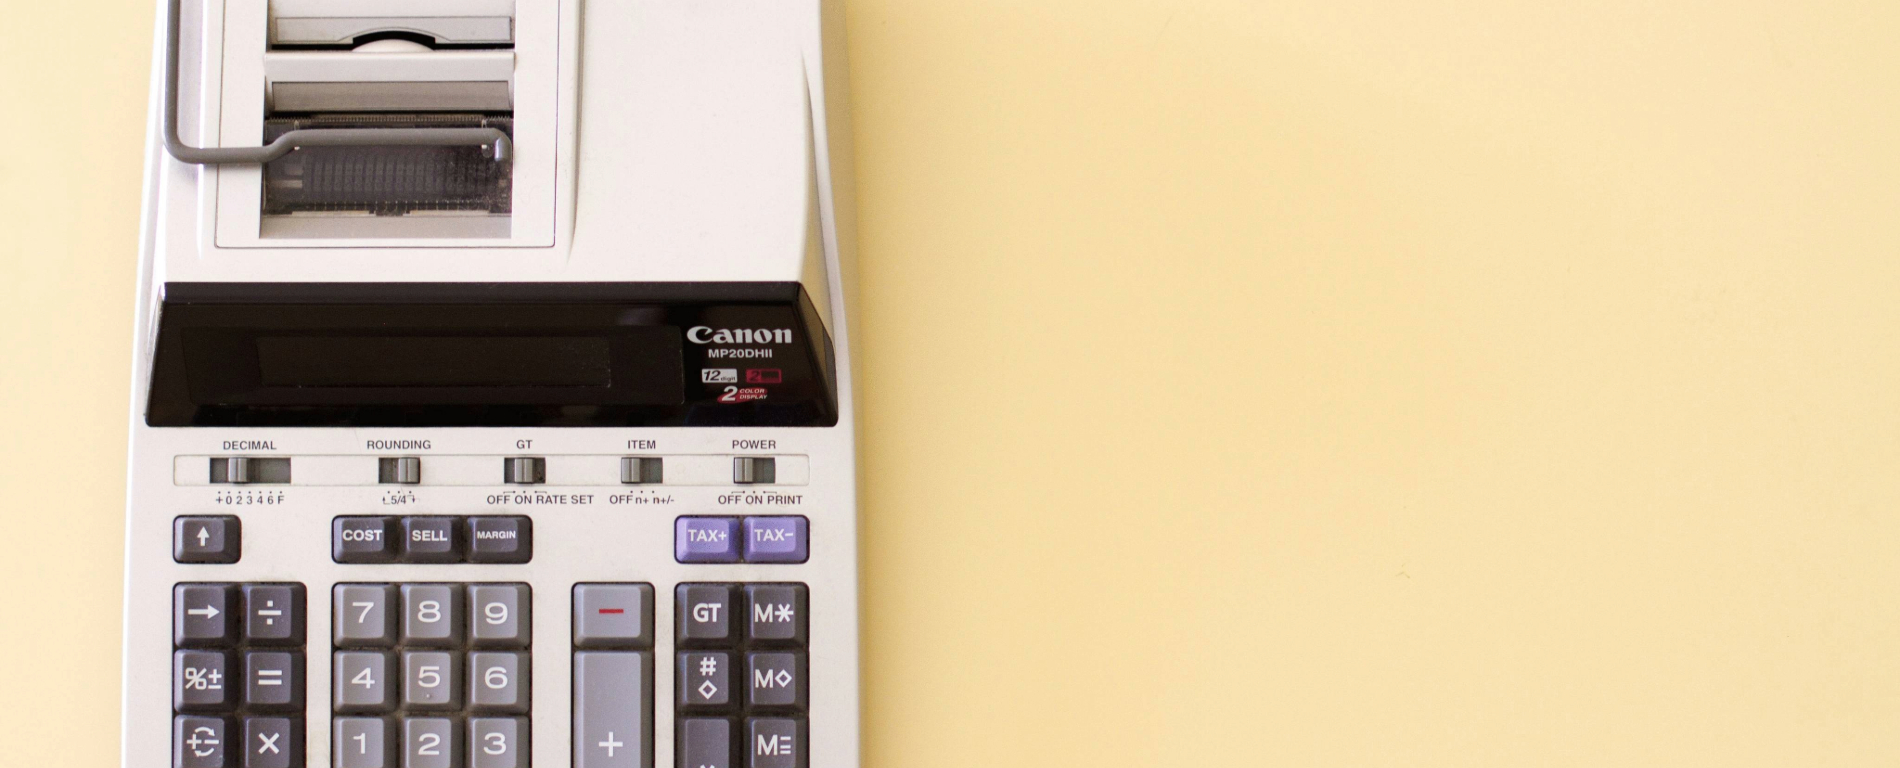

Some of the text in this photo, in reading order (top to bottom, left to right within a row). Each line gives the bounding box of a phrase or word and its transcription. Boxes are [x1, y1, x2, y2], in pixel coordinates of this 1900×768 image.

[687, 326, 792, 344] Canon
[708, 349, 772, 358] MP20DHII
[704, 370, 721, 381] 12
[722, 386, 738, 401] 2
[223, 440, 276, 450] DECIMAL
[367, 440, 431, 450] ROUNDING
[516, 440, 532, 449] GT
[628, 440, 656, 449] ITEM
[732, 440, 776, 449] POWER
[226, 496, 232, 505] 0
[236, 496, 242, 505] 2
[247, 496, 252, 505] 3
[257, 496, 263, 505] 4
[267, 496, 273, 505] 6
[278, 496, 284, 505] F
[487, 495, 594, 505] OFF ON RATE SET
[610, 494, 632, 505] OFF
[718, 495, 802, 505] OFF ON PRINT
[343, 529, 382, 542] COST
[412, 530, 447, 542] SELL
[477, 530, 516, 539] MARGIN
[688, 529, 727, 542] TAX+
[352, 602, 374, 624] 7
[417, 601, 441, 623] 8
[484, 602, 508, 625] 9
[693, 603, 721, 623] GT
[352, 667, 375, 689] 4
[418, 666, 440, 688] 5
[484, 667, 508, 689] 6
[353, 733, 366, 754] 1
[418, 732, 440, 755] 2
[483, 732, 506, 754] 3
